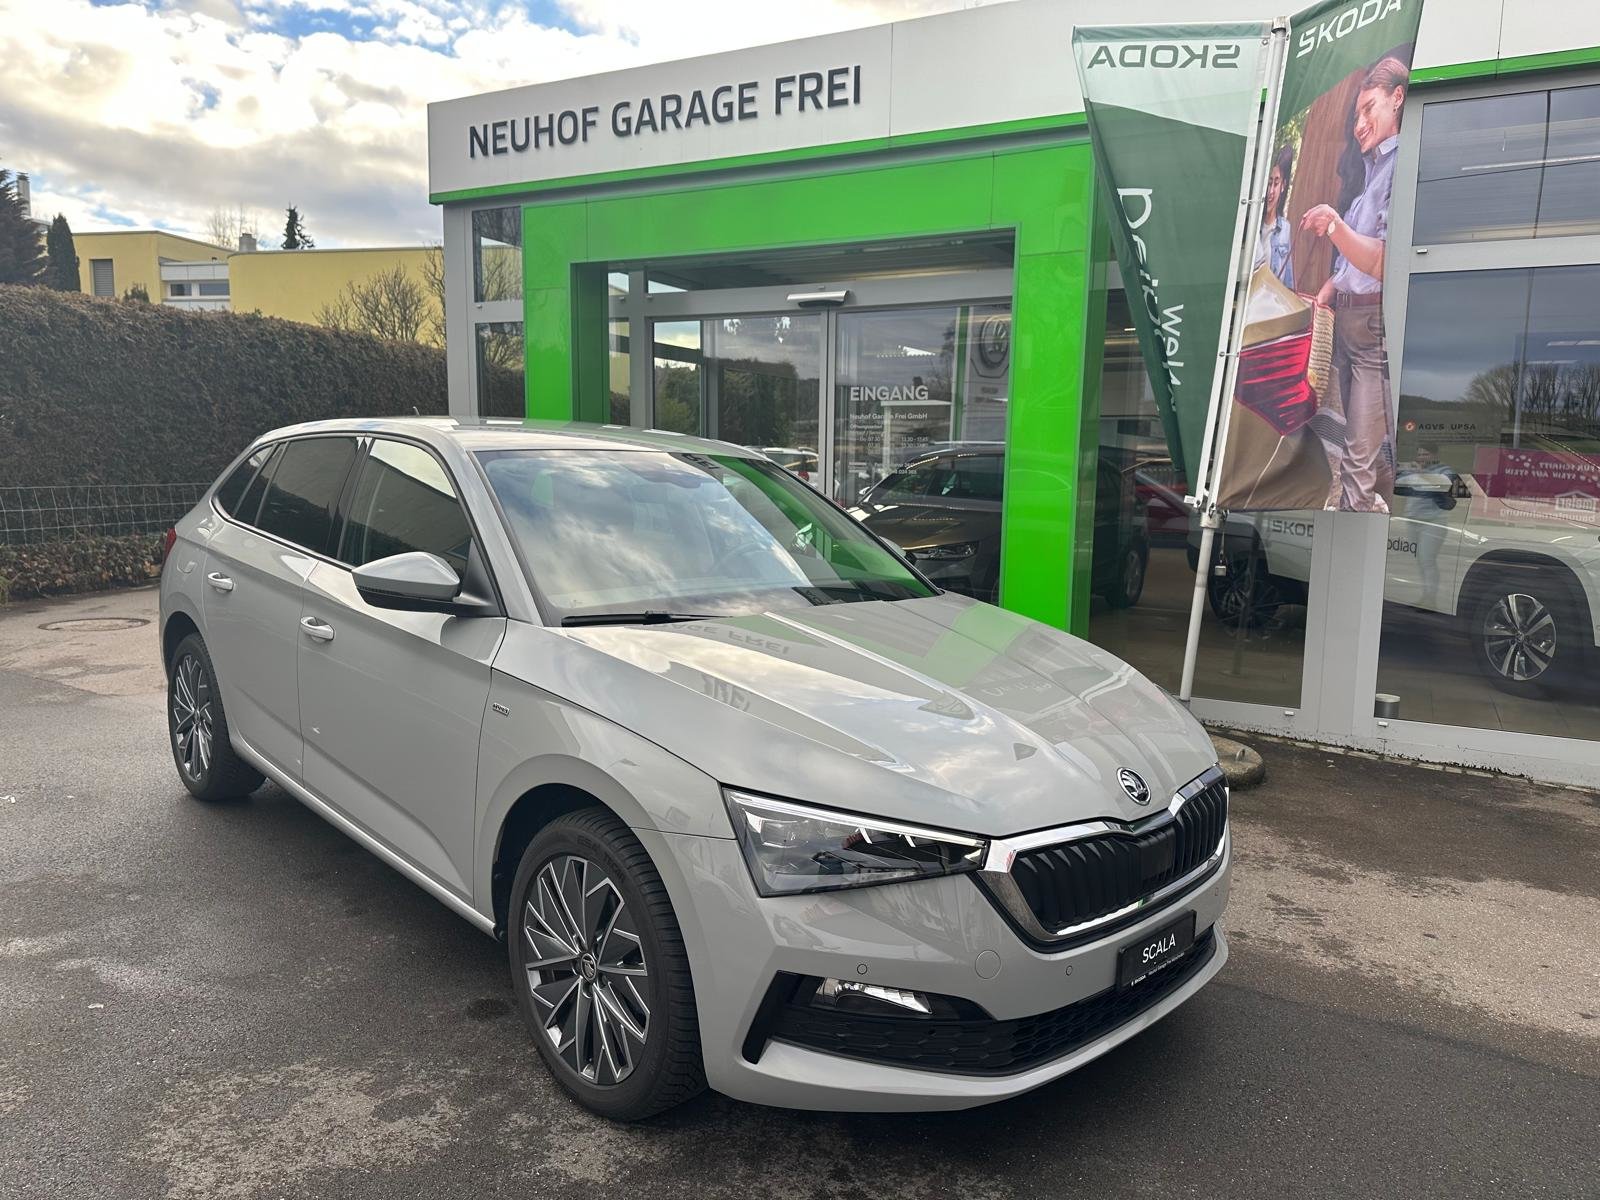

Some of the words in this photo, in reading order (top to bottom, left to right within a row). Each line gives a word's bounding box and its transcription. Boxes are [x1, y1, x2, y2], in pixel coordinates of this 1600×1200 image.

[468, 106, 599, 158] NEUHOF
[611, 81, 759, 138] GARAGE
[774, 65, 862, 115] FREI
[849, 385, 929, 402] EINGANG
[1272, 519, 1314, 538] SKOD
[1386, 536, 1418, 558] odiaq
[1142, 932, 1176, 964] SCALA
